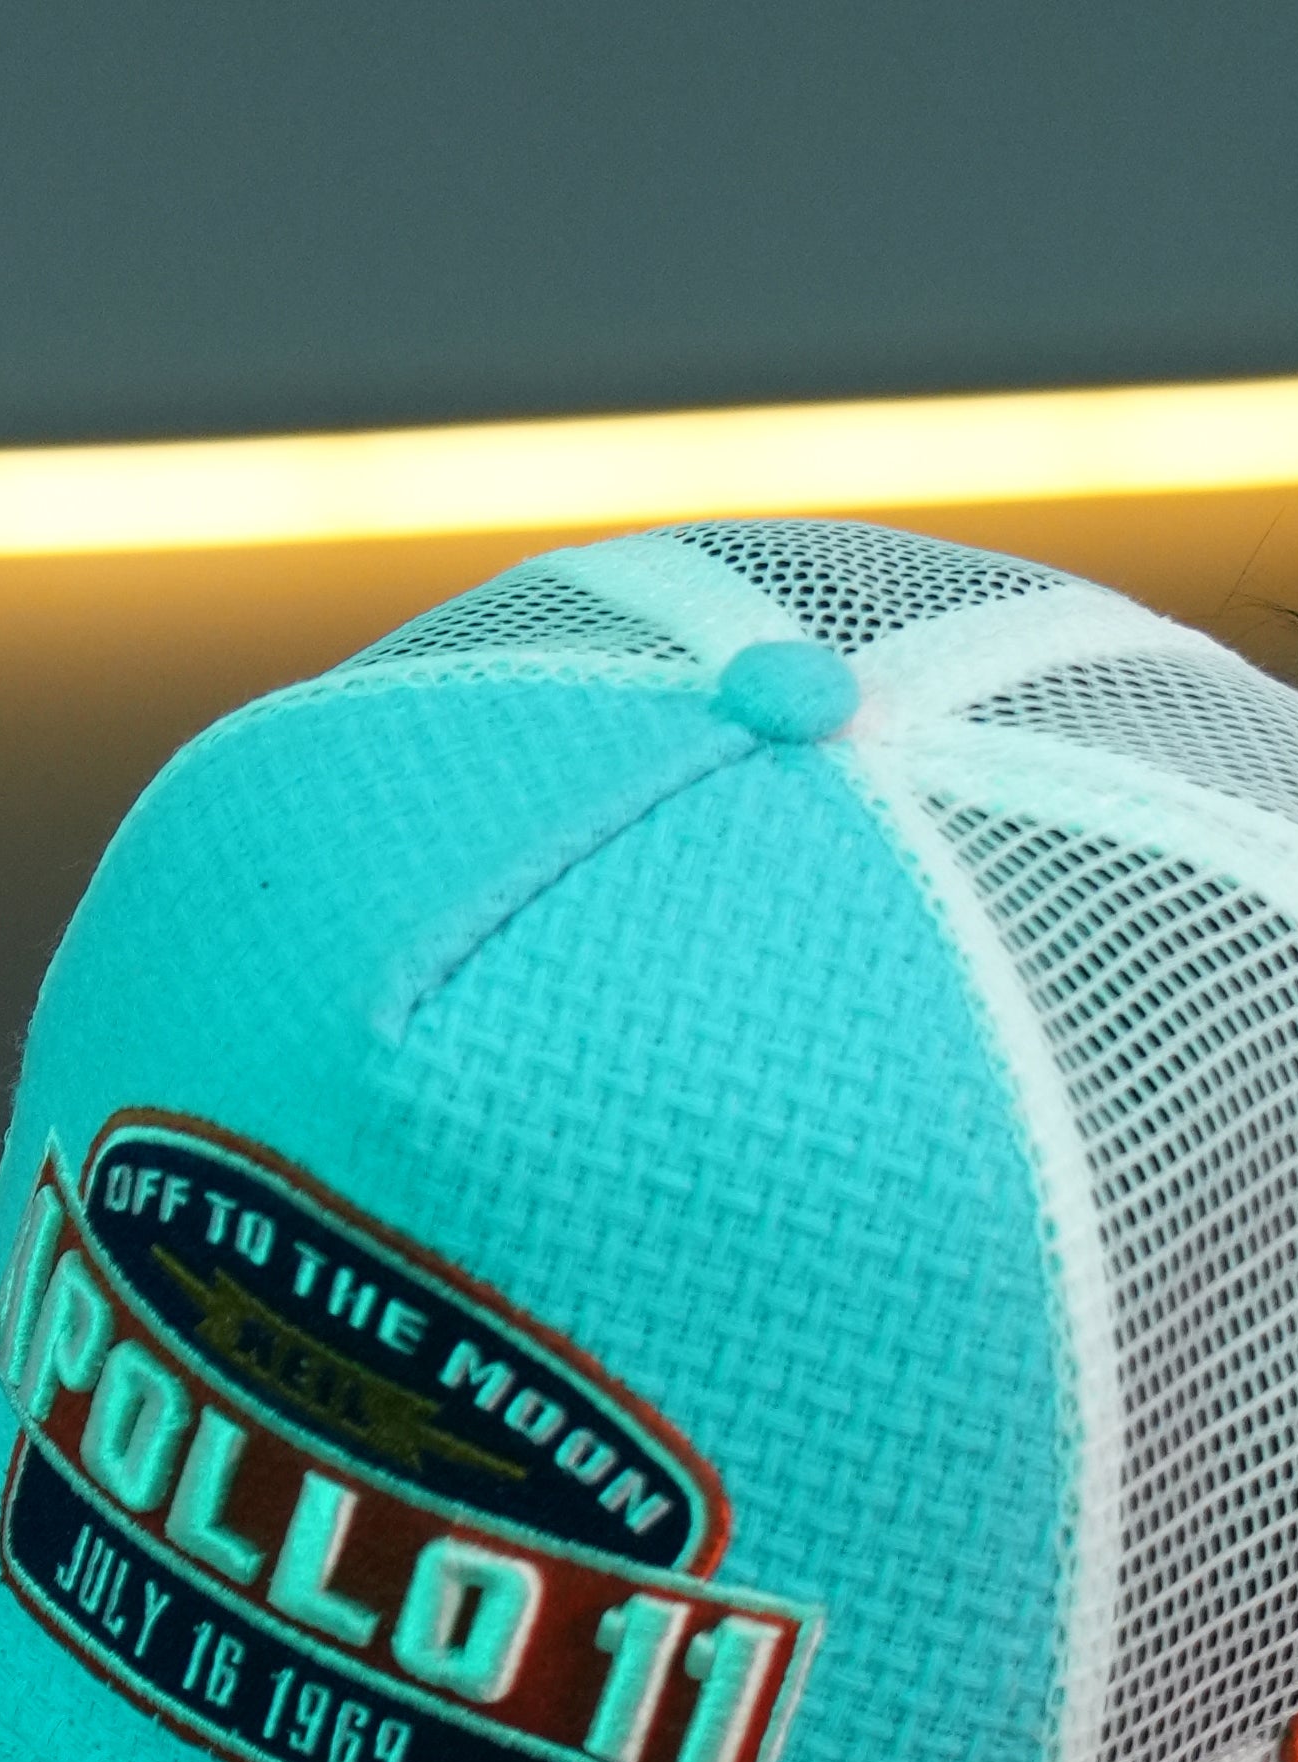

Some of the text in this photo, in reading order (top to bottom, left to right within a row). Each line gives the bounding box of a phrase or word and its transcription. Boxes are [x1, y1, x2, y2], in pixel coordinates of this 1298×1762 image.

[106, 1163, 675, 1536] OFF TO THE MOON
[55, 1523, 171, 1658] JULY
[182, 1618, 244, 1709] 16
